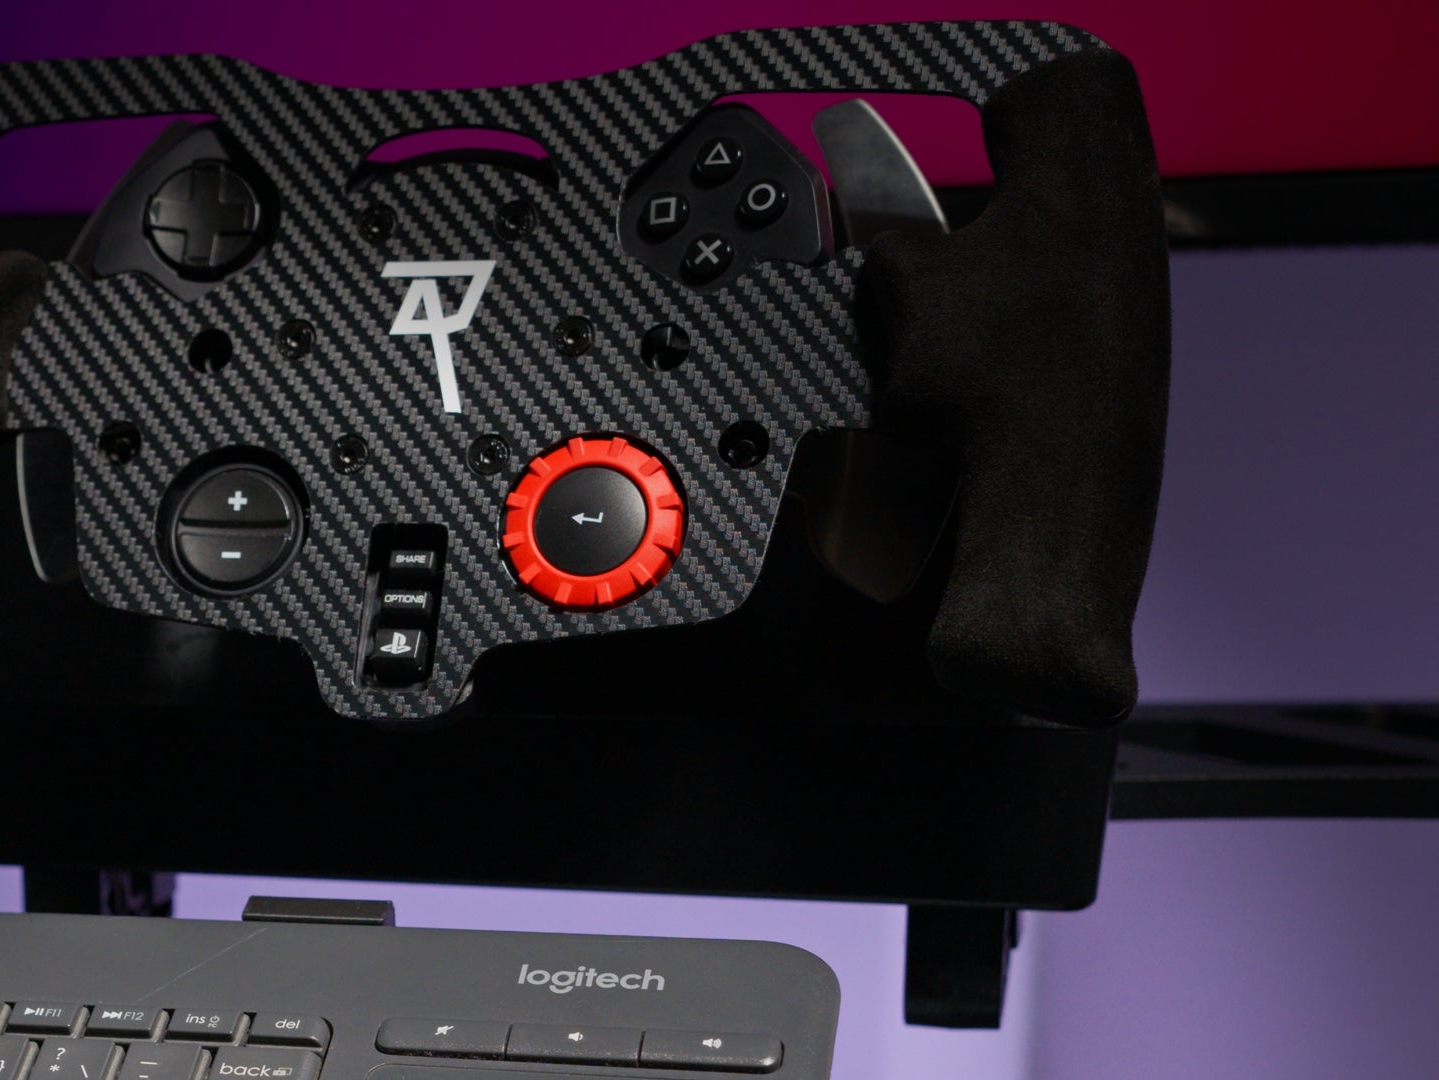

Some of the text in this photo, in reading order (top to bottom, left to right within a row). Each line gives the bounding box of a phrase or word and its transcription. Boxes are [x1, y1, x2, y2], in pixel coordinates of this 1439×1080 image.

[395, 554, 427, 564] SHARE
[384, 594, 424, 604] OPTIONS
[518, 964, 665, 994] logitech
[45, 1009, 61, 1017] F11
[124, 1012, 144, 1020] F12
[186, 1014, 205, 1024] ins
[276, 1019, 300, 1029] del
[56, 1048, 65, 1060] ?
[220, 1063, 270, 1076] back
